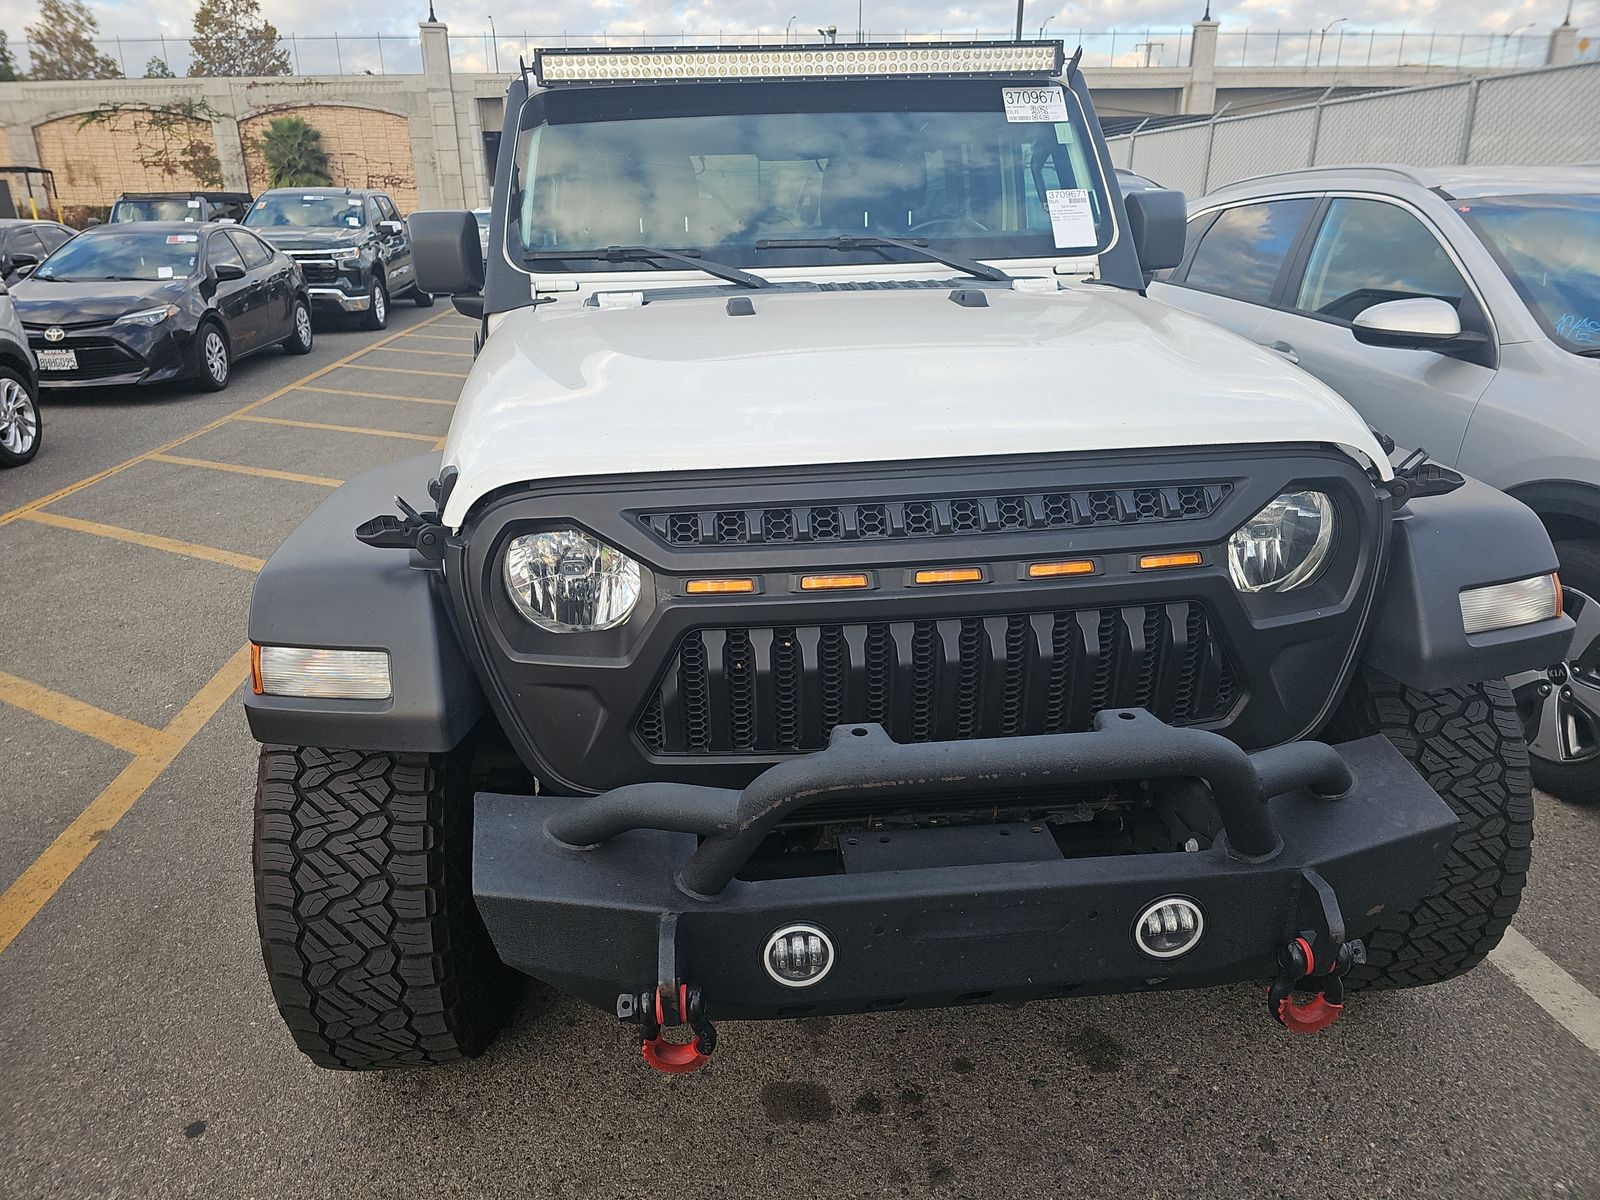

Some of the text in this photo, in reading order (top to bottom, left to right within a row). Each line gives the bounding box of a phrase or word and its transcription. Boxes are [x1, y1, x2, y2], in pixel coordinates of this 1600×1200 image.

[1005, 91, 1062, 104] 3709671
[1048, 190, 1087, 199] 3709671
[1549, 669, 1565, 677] KIA
